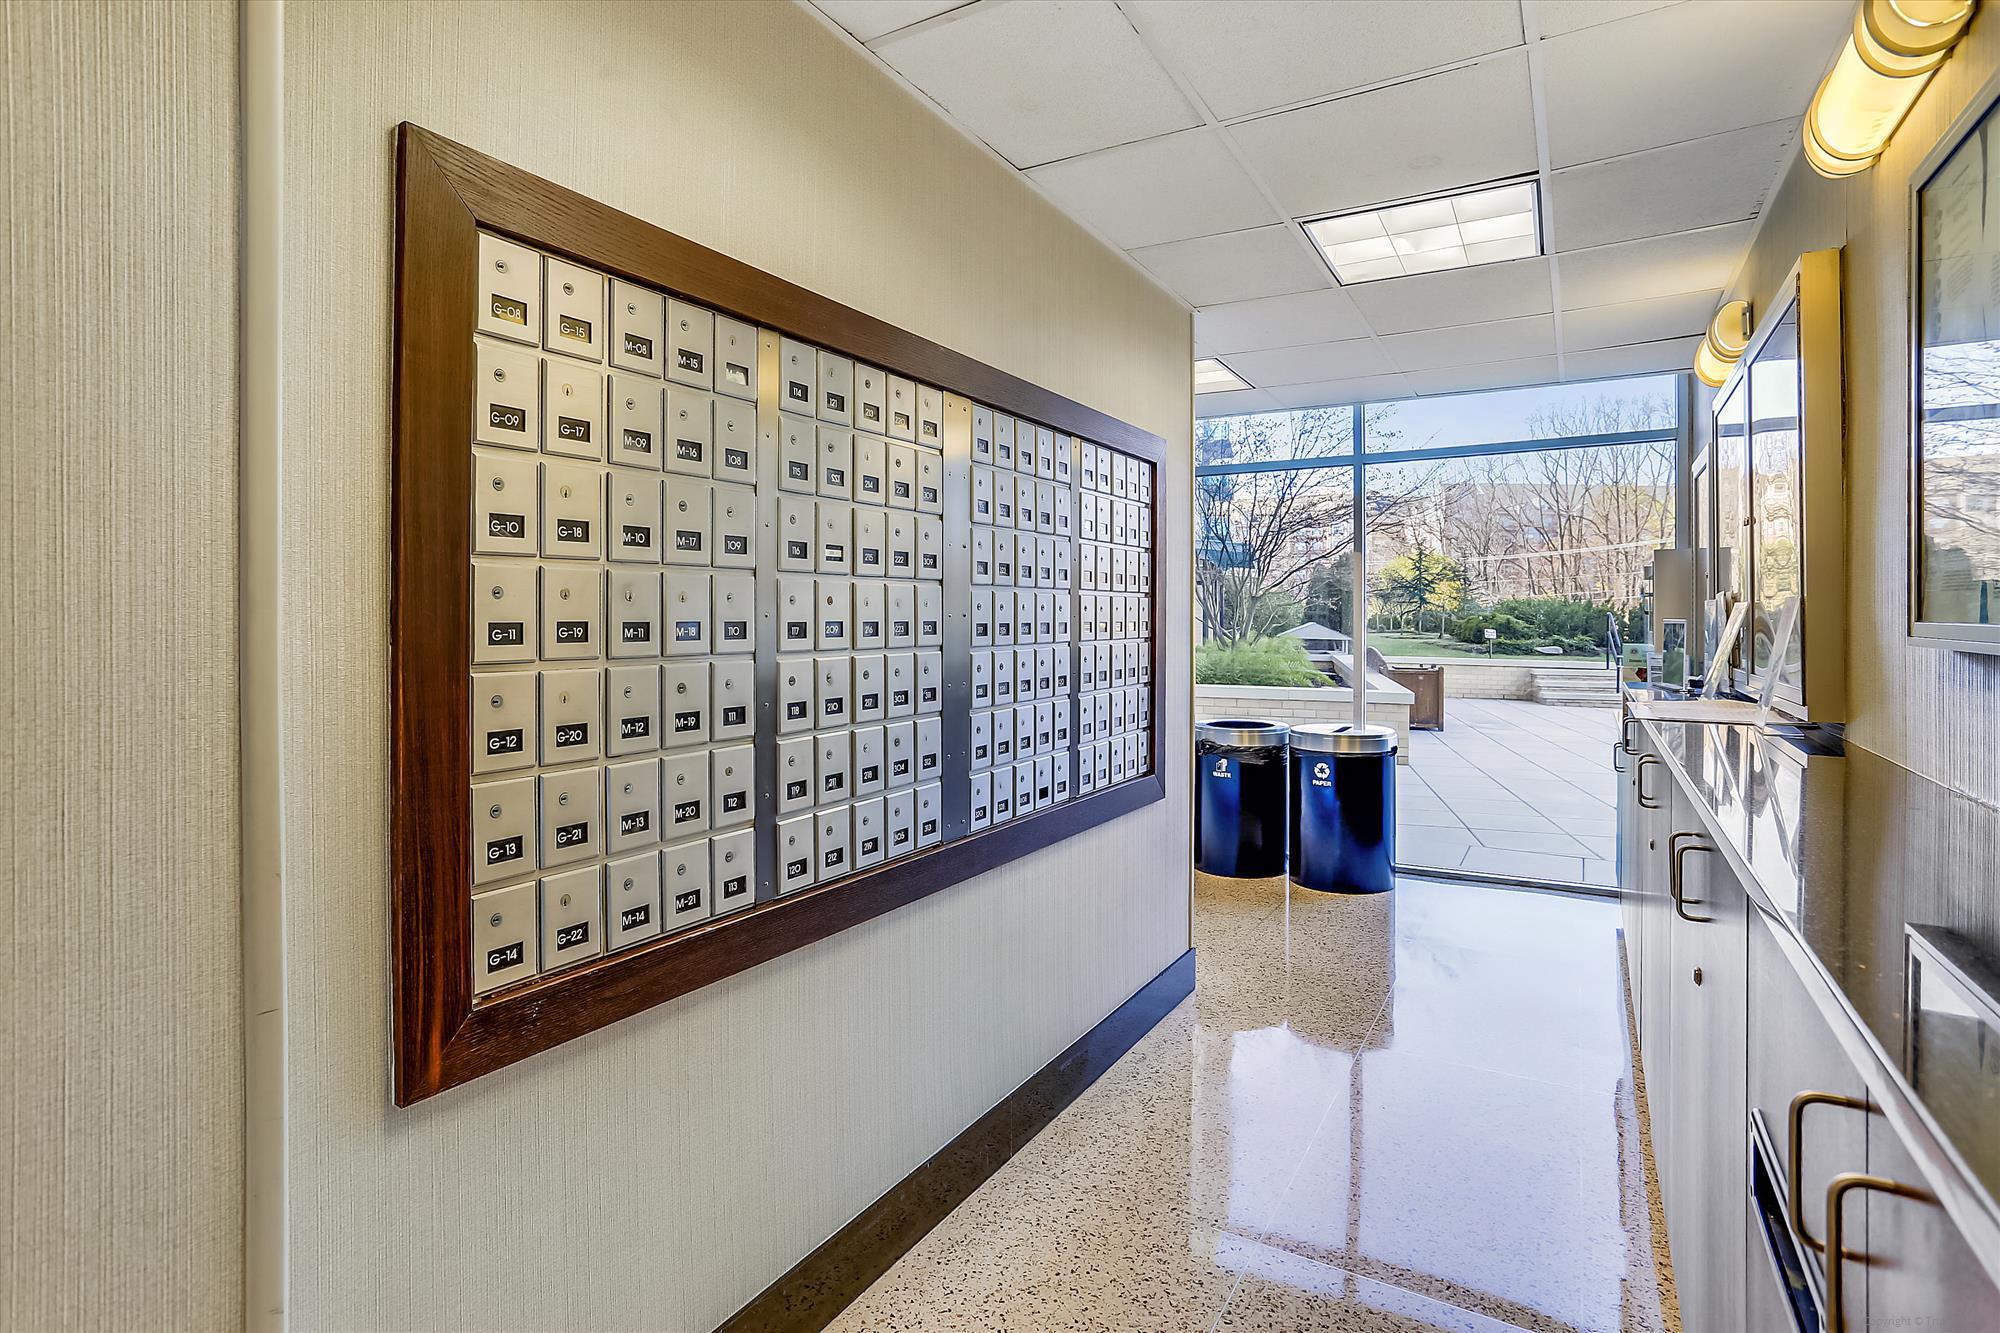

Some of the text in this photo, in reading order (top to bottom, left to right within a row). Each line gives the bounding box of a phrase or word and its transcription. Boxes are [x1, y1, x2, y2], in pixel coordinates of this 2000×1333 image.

[493, 302, 521, 320] G-08
[560, 322, 585, 338] G-15
[625, 340, 647, 355] M-08
[678, 354, 699, 369] M-15
[793, 387, 802, 397] 114
[829, 398, 838, 407] 121
[491, 411, 520, 428] G-09
[560, 424, 585, 438] G-17
[624, 435, 647, 448] M-09
[677, 447, 698, 458] M-16
[727, 454, 742, 466] 108
[792, 466, 801, 476] 115
[864, 479, 874, 489] 214
[490, 519, 519, 533] G-10
[558, 526, 582, 538] G-18
[623, 532, 645, 543] M-10
[677, 536, 697, 547] M-17
[727, 540, 742, 550] 109
[791, 546, 800, 555] 116
[894, 556, 904, 564] 222
[923, 557, 934, 565] 309
[558, 627, 584, 638] G-19
[624, 627, 644, 638] M-11
[676, 626, 696, 637] M-18
[727, 626, 740, 636] 110
[791, 627, 800, 635] 117
[825, 625, 839, 634] 209
[894, 625, 904, 633] 223
[491, 629, 516, 641] G-11
[864, 698, 873, 707] 217
[894, 694, 905, 703] 303
[791, 705, 800, 715] 118
[827, 701, 838, 712] 210
[728, 711, 737, 721] 111
[622, 722, 644, 734] M-12
[675, 717, 696, 728] M-19
[557, 730, 582, 742] G-20
[489, 735, 517, 749] G-12
[894, 763, 905, 773] 304
[863, 770, 873, 780] 218
[828, 777, 837, 787] 211
[1312, 779, 1332, 787] PAPER
[791, 785, 800, 796] 119
[727, 797, 738, 808] 112
[675, 806, 696, 818] M-20
[622, 817, 645, 831] M-13
[557, 828, 582, 843] G-21
[894, 832, 905, 842] 305
[488, 843, 516, 859] G-13
[864, 841, 873, 851] 219
[827, 852, 838, 862] 212
[789, 863, 801, 875] 120
[728, 881, 738, 892] 113
[676, 895, 696, 909] M-21
[622, 911, 645, 926] M-14
[557, 929, 583, 944] G-22
[489, 949, 518, 966] G-14
